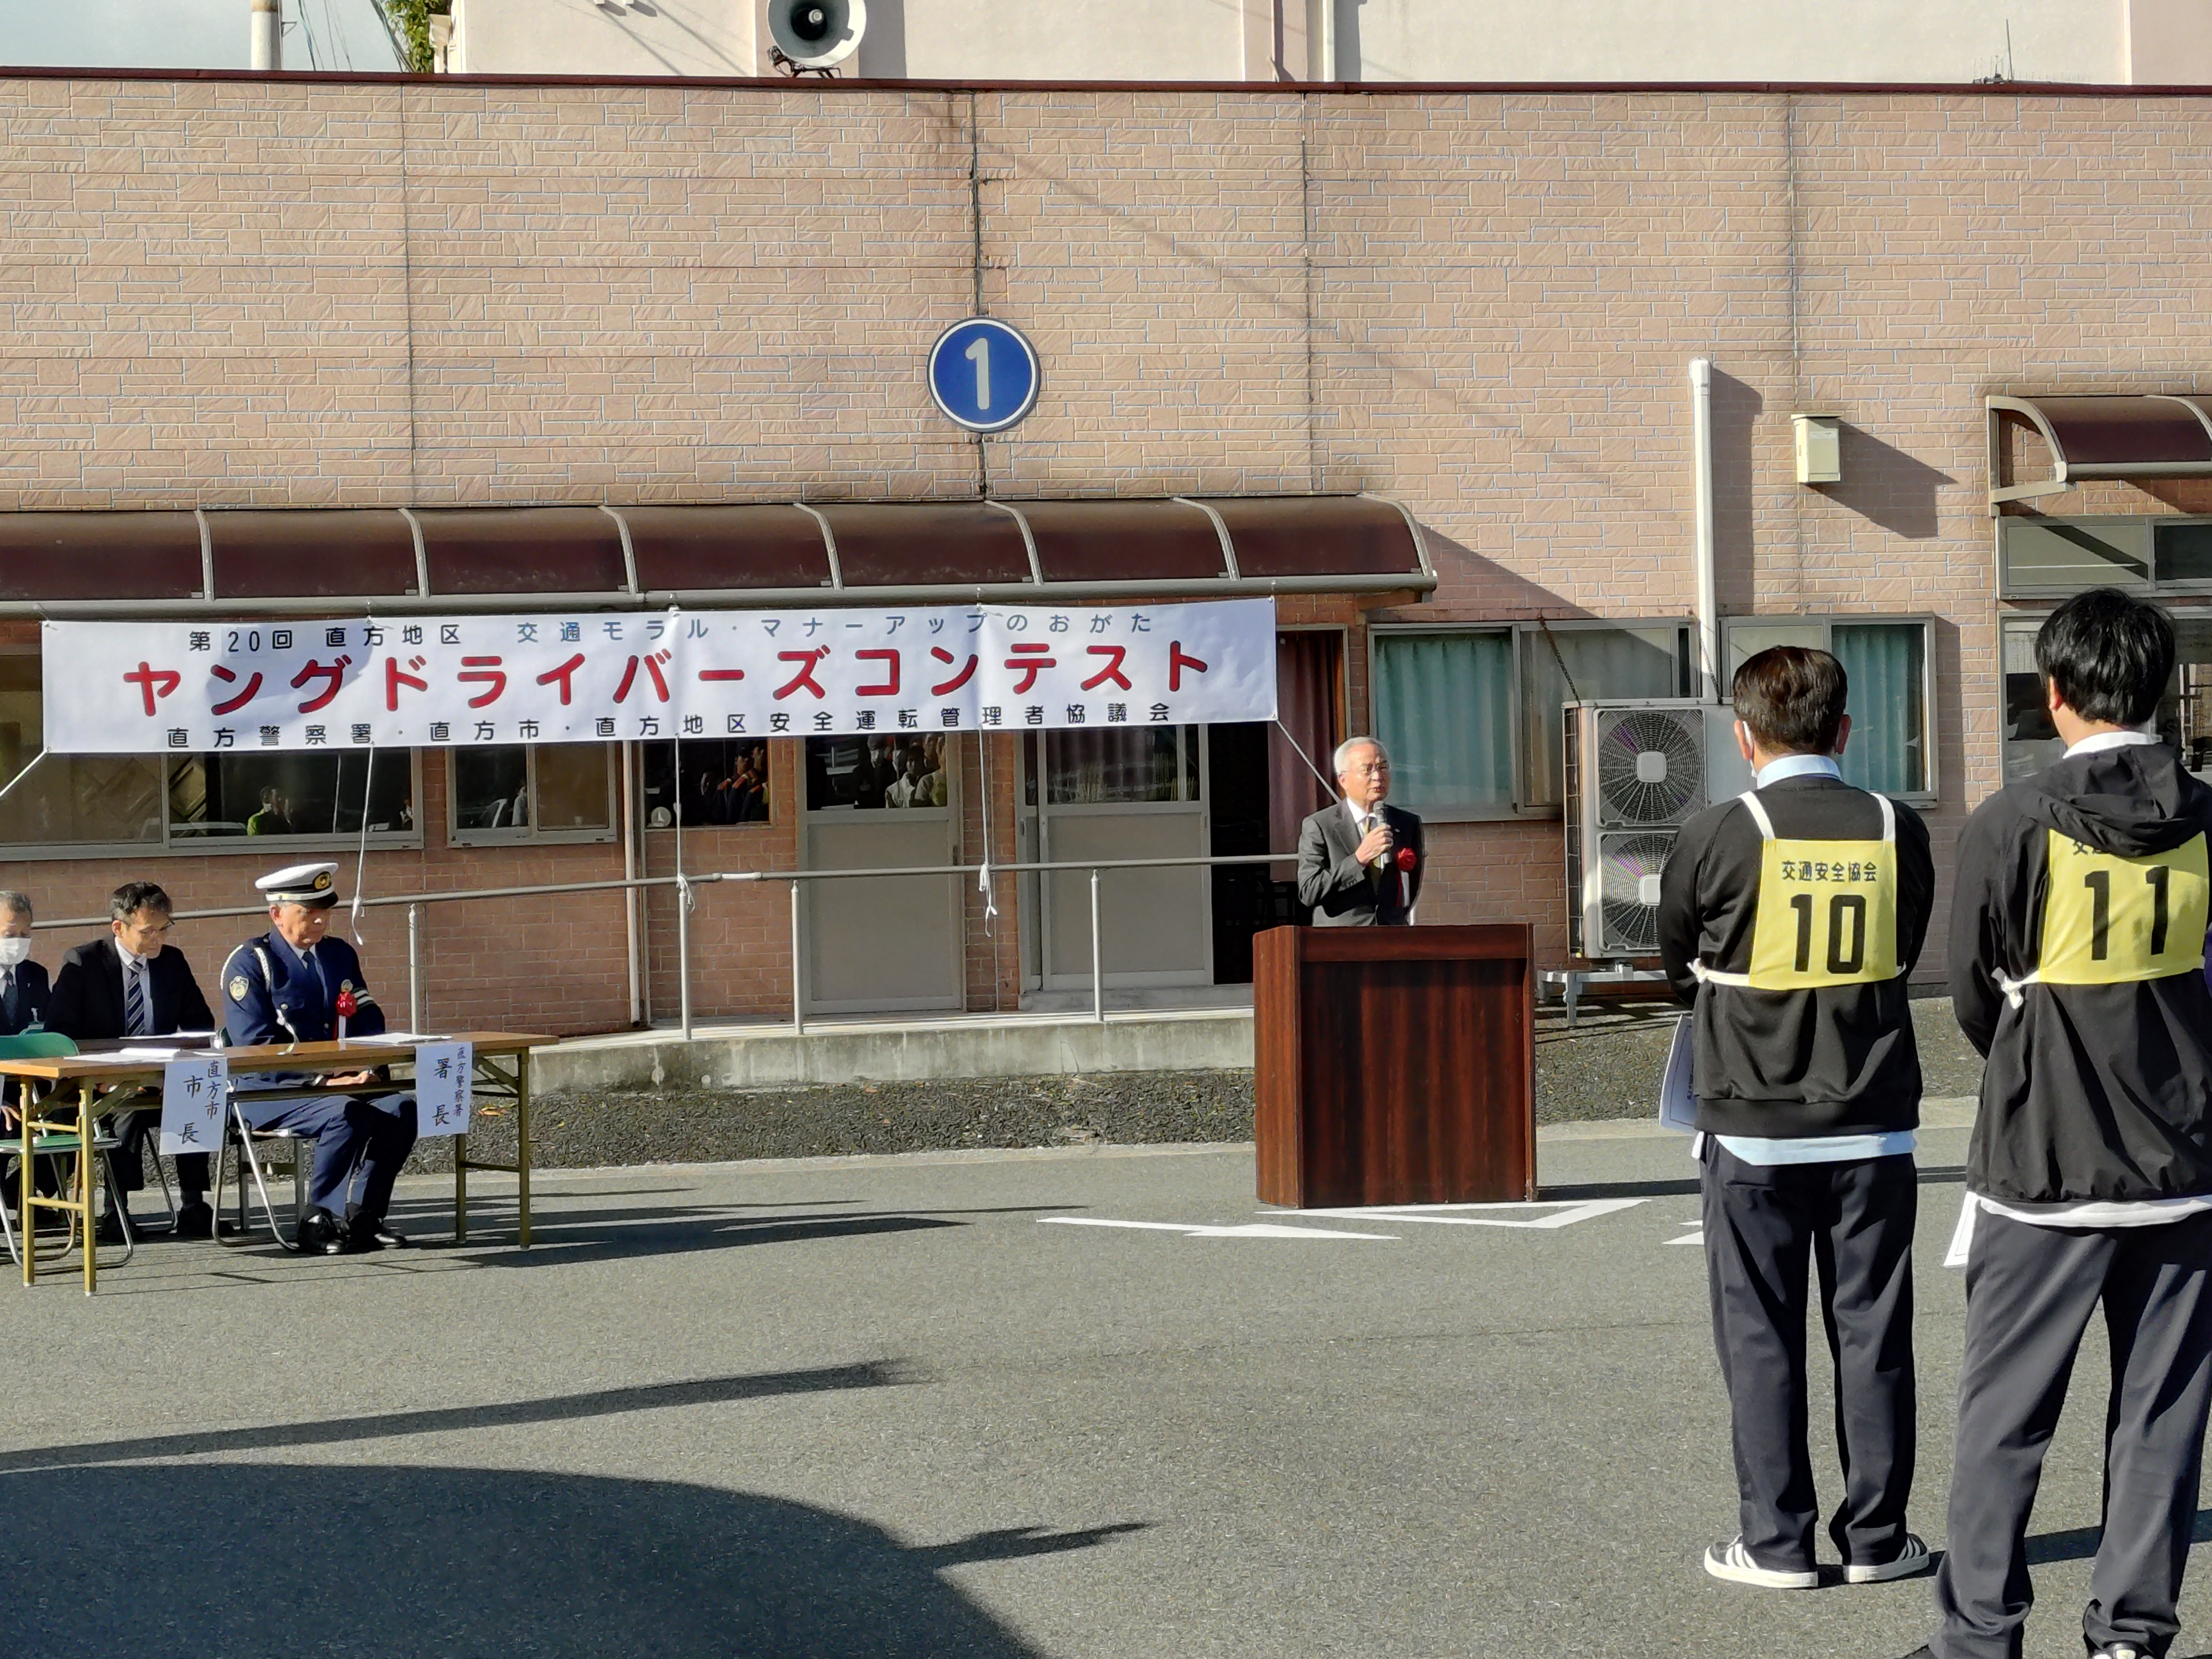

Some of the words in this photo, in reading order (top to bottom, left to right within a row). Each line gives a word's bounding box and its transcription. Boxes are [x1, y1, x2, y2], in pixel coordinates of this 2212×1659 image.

[965, 338, 989, 410] 1
[190, 630, 293, 653] 第20回
[325, 624, 460, 648] 直方地区
[123, 640, 1208, 717] ヤングドライバーズコンテスト
[1782, 860, 1877, 882] 交通安全協会
[1790, 894, 1866, 974] 10
[2084, 865, 2170, 961] 11
[205, 1060, 222, 1120] 直方市
